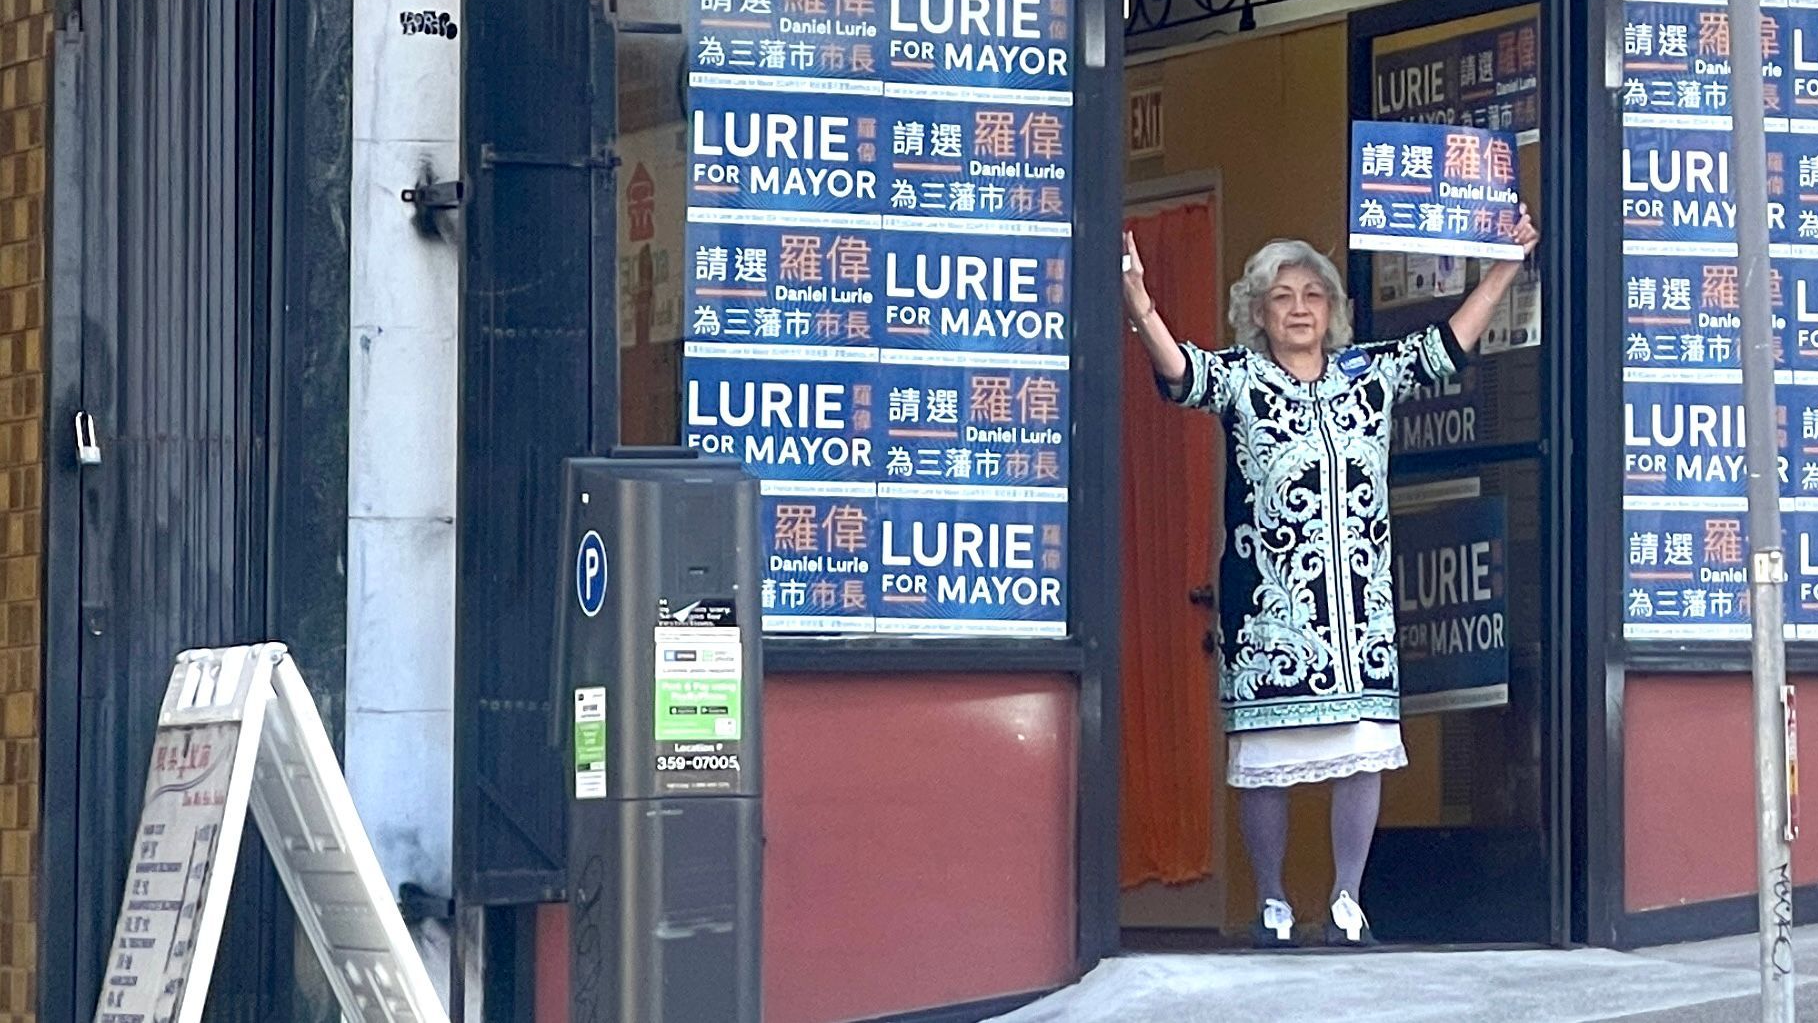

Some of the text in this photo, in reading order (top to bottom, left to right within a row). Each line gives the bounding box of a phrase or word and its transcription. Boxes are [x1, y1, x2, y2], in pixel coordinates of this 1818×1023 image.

[780, 18, 876, 38] Daniel Lurie
[1624, 23, 1688, 56] 請選
[698, 37, 875, 72] 為三藩市市長
[891, 41, 1067, 76] FOR MAYOR
[1378, 61, 1444, 114] LURIE
[694, 111, 848, 161] LURIE
[892, 121, 962, 158] 請選
[974, 111, 1064, 161] 羅偉
[1130, 93, 1161, 151] EXIT
[970, 161, 1064, 180] Daniel Lurie
[1362, 134, 1514, 185] 請選 羅偉
[1622, 150, 1727, 192] LURI
[693, 165, 876, 199] FOR MAYOR
[891, 180, 1063, 214] 為三藩市市長
[1439, 182, 1518, 204] Daniel Lurie
[1359, 198, 1516, 239] 為三藩市市長
[1623, 200, 1784, 229] FOR MAYR
[695, 234, 871, 284] 請選 羅偉
[887, 253, 1037, 302] LURIE
[1628, 276, 1691, 311] 請選
[775, 286, 873, 304] Daniel Lurie
[693, 305, 871, 339] 為三藩市市長
[887, 306, 1064, 339] FOR MAYOR
[1699, 313, 1740, 329] Danie
[688, 380, 844, 429] LURIE
[889, 387, 957, 423] 請選
[970, 376, 1059, 425] 羅偉
[966, 427, 1061, 445] Daniel Lurie
[1404, 407, 1475, 450] MAYOR
[689, 435, 871, 467] FOR MAYOR
[886, 446, 1058, 479] 為三藩市市長
[1625, 455, 1788, 483] FOR MAYR
[775, 504, 867, 553] 羅偉
[882, 522, 1033, 568] LURIE
[771, 555, 869, 573] Daniel Lurie
[1630, 533, 1693, 566] 請選
[883, 575, 1060, 606] FOR MAYOR
[1398, 541, 1491, 611] LURIE
[1701, 567, 1747, 583] Daniel
[1400, 613, 1504, 656] FOR MAYOR
[657, 756, 737, 771] 359-07005
[675, 744, 714, 752] Location
